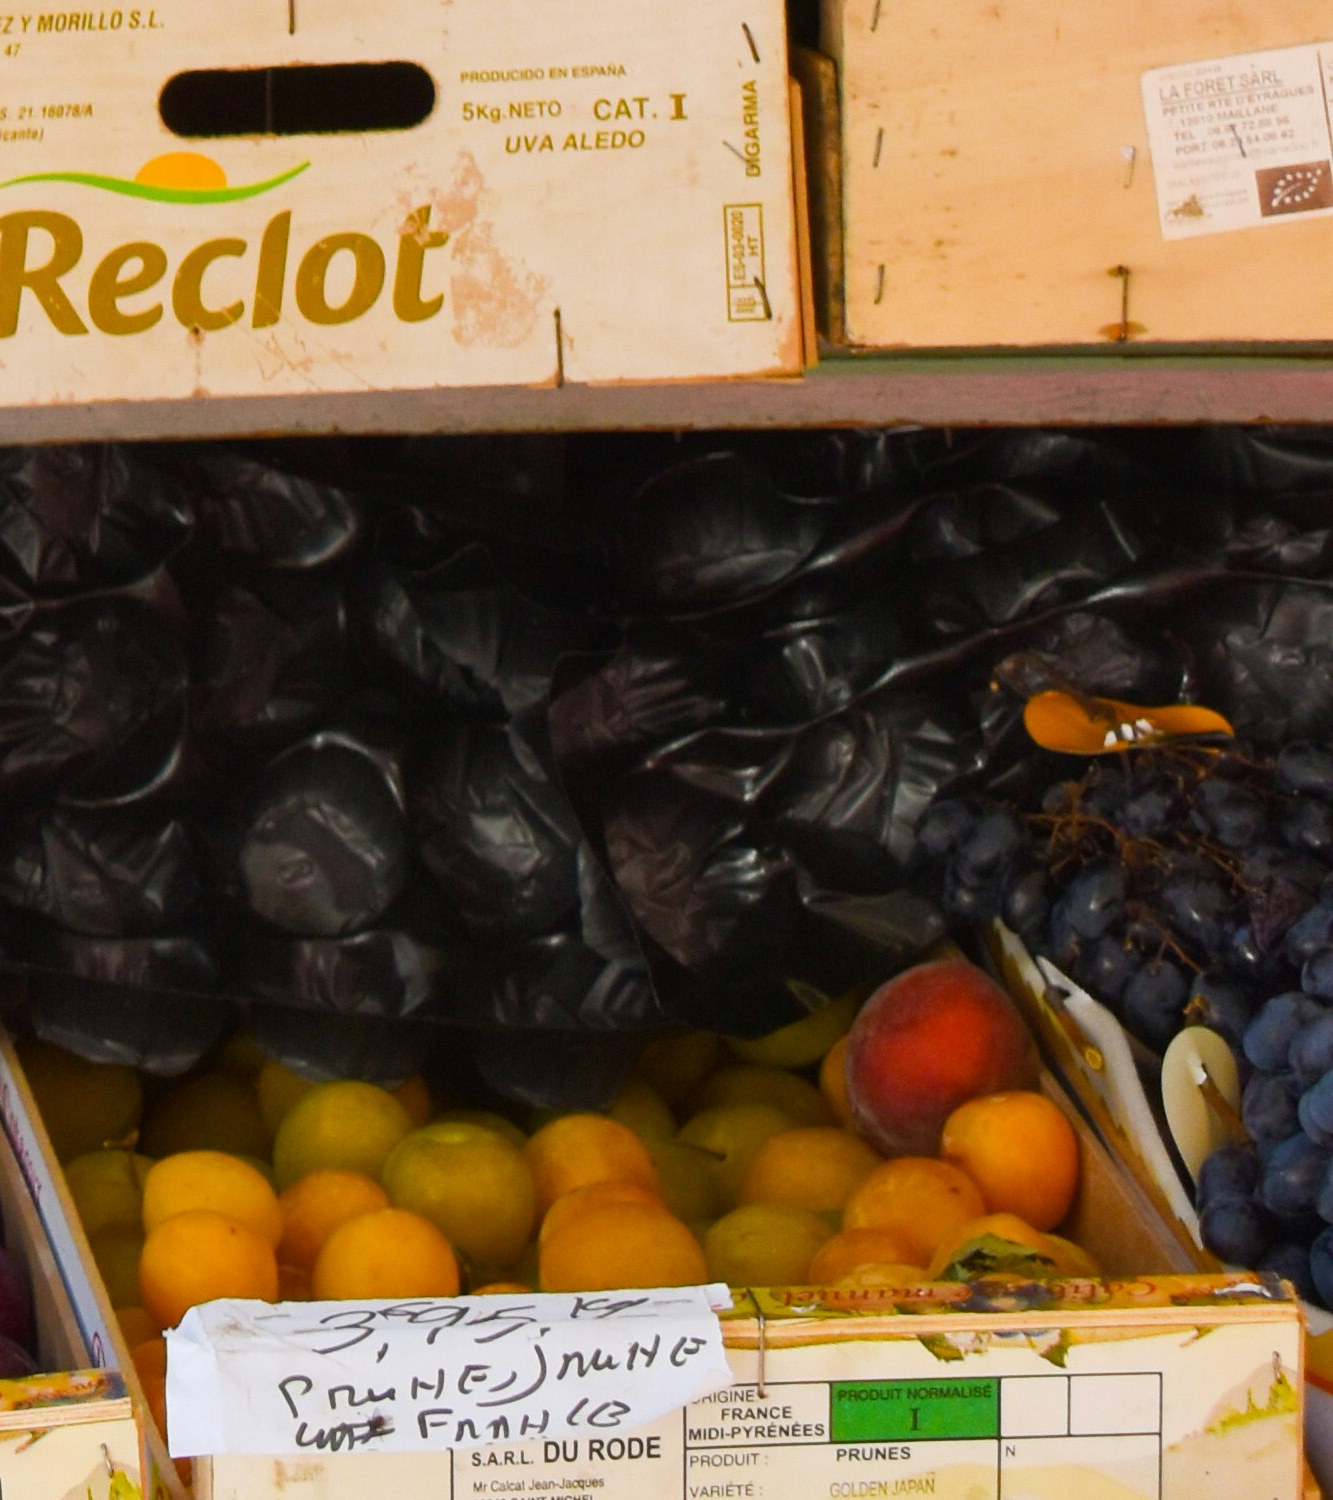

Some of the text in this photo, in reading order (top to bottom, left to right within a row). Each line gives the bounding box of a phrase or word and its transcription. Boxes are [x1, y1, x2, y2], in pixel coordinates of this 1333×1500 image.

[20, 13, 33, 34] Y
[37, 10, 123, 33] MORILLO
[127, 9, 166, 30] S.L.
[4, 43, 22, 58] 47
[459, 62, 627, 84] PRODUCIDO EN ESPAÑA
[592, 96, 658, 122] CAT.
[505, 129, 646, 154] UVA ALEDO
[837, 1384, 992, 1402] PRODUIT NORMALISÉ
[721, 1405, 793, 1422] FRANCE
[688, 1423, 826, 1442] MIDI-PYRÉNÉES
[471, 1436, 662, 1467] S.A.R.L. DU RODE
[836, 1446, 912, 1463] PRUNES
[1004, 1445, 1017, 1458] N
[472, 1477, 606, 1493] Mr Calcat Jean-Jacques
[829, 1480, 888, 1498] GOLDEN
[892, 1478, 936, 1495] JAPAN
